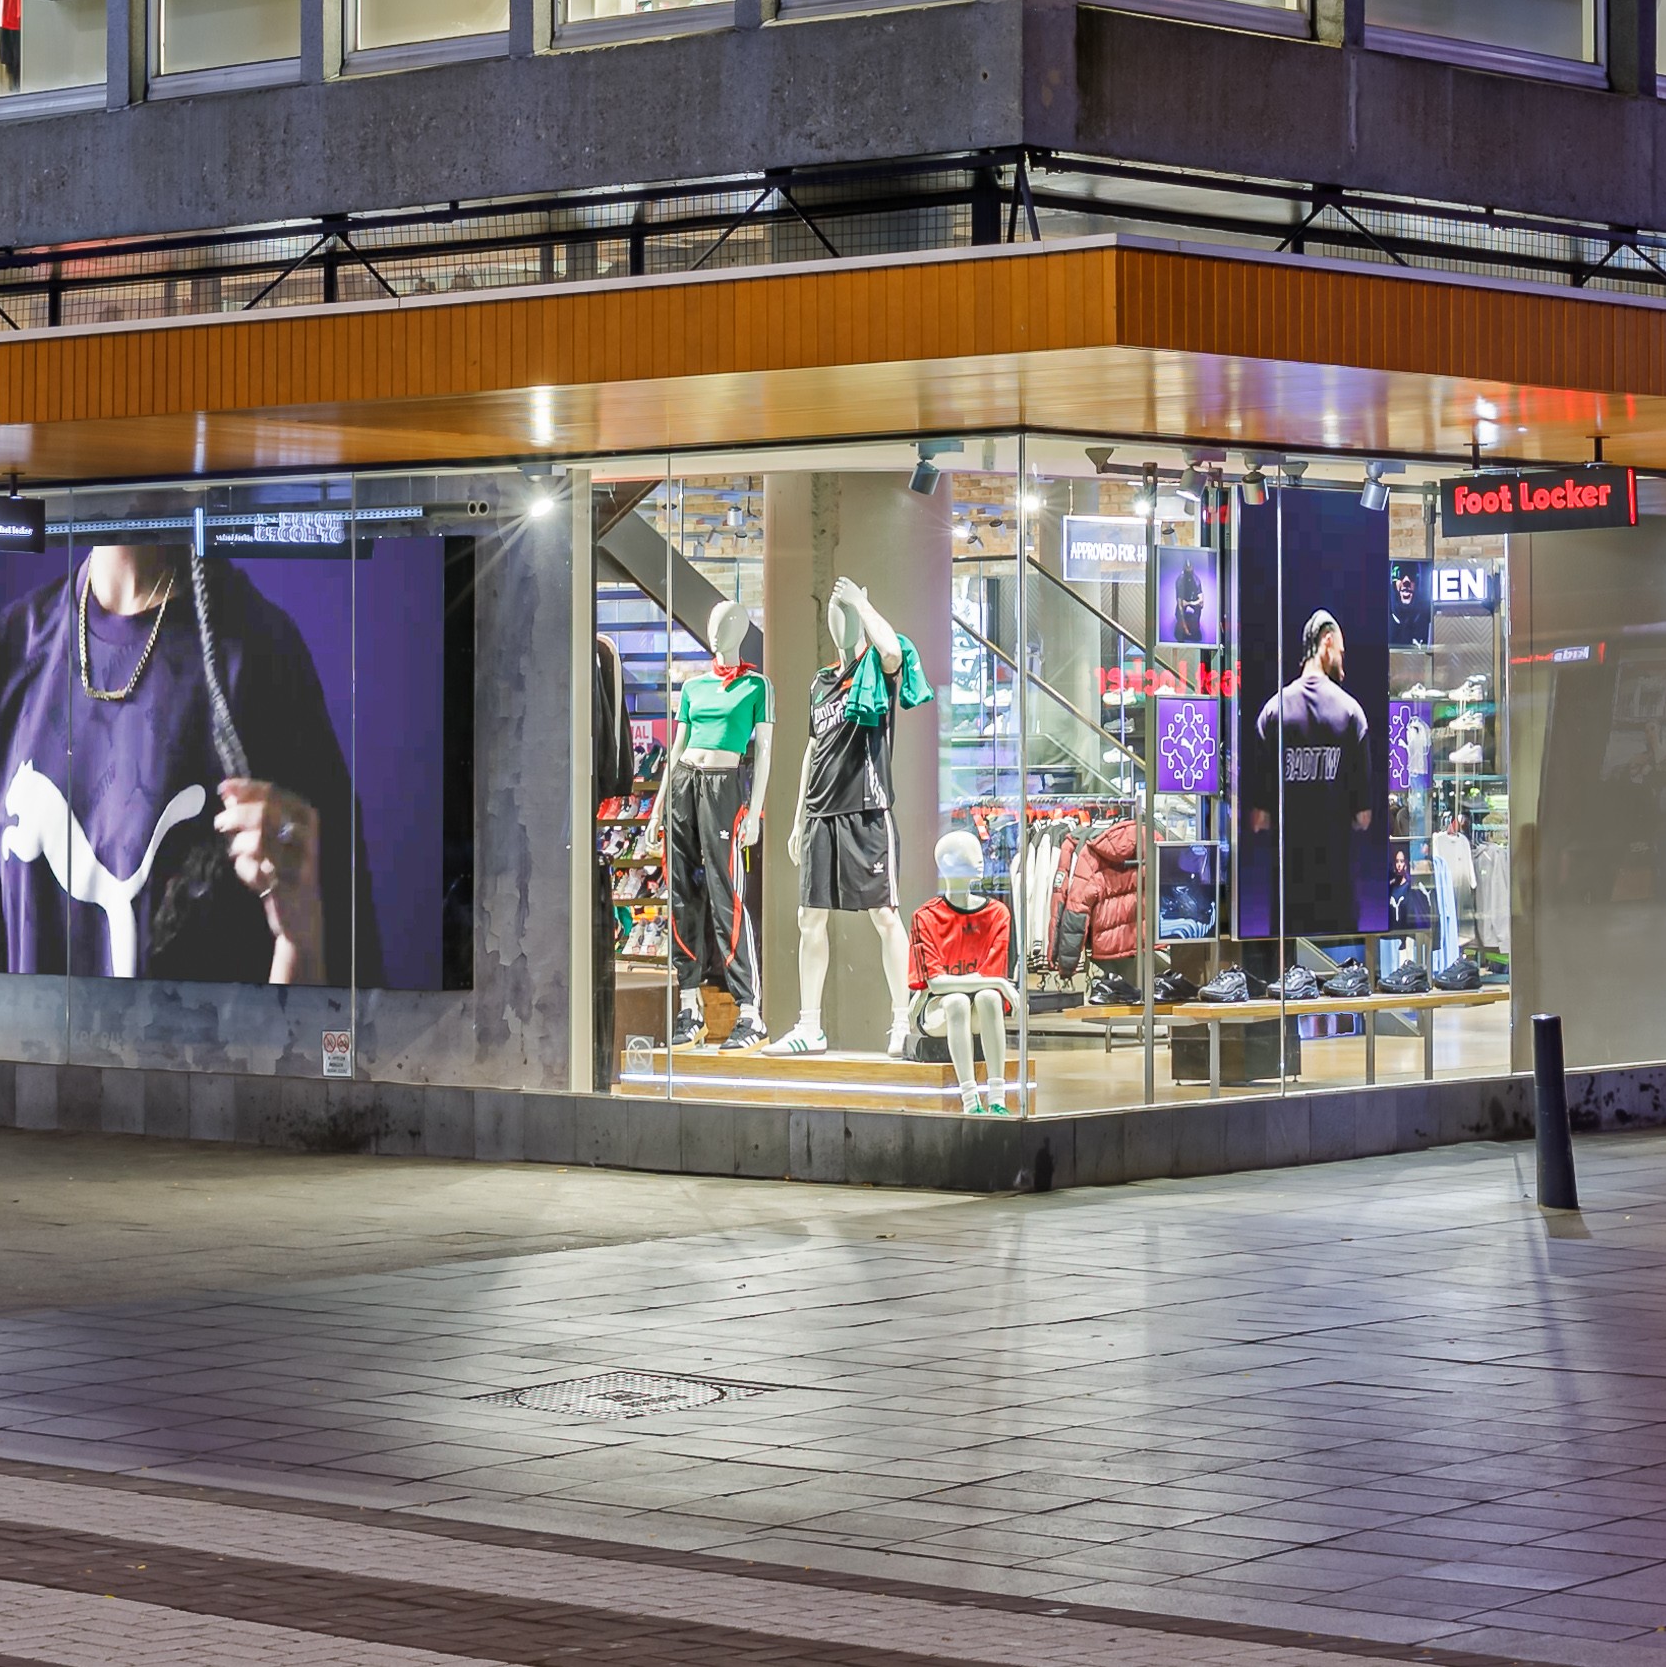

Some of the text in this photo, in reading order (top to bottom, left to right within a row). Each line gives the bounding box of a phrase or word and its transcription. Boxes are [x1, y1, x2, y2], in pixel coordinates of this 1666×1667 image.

[1454, 479, 1612, 516] Foot Locker
[1070, 541, 1117, 561] APPROVED
[1118, 543, 1136, 563] FOR
